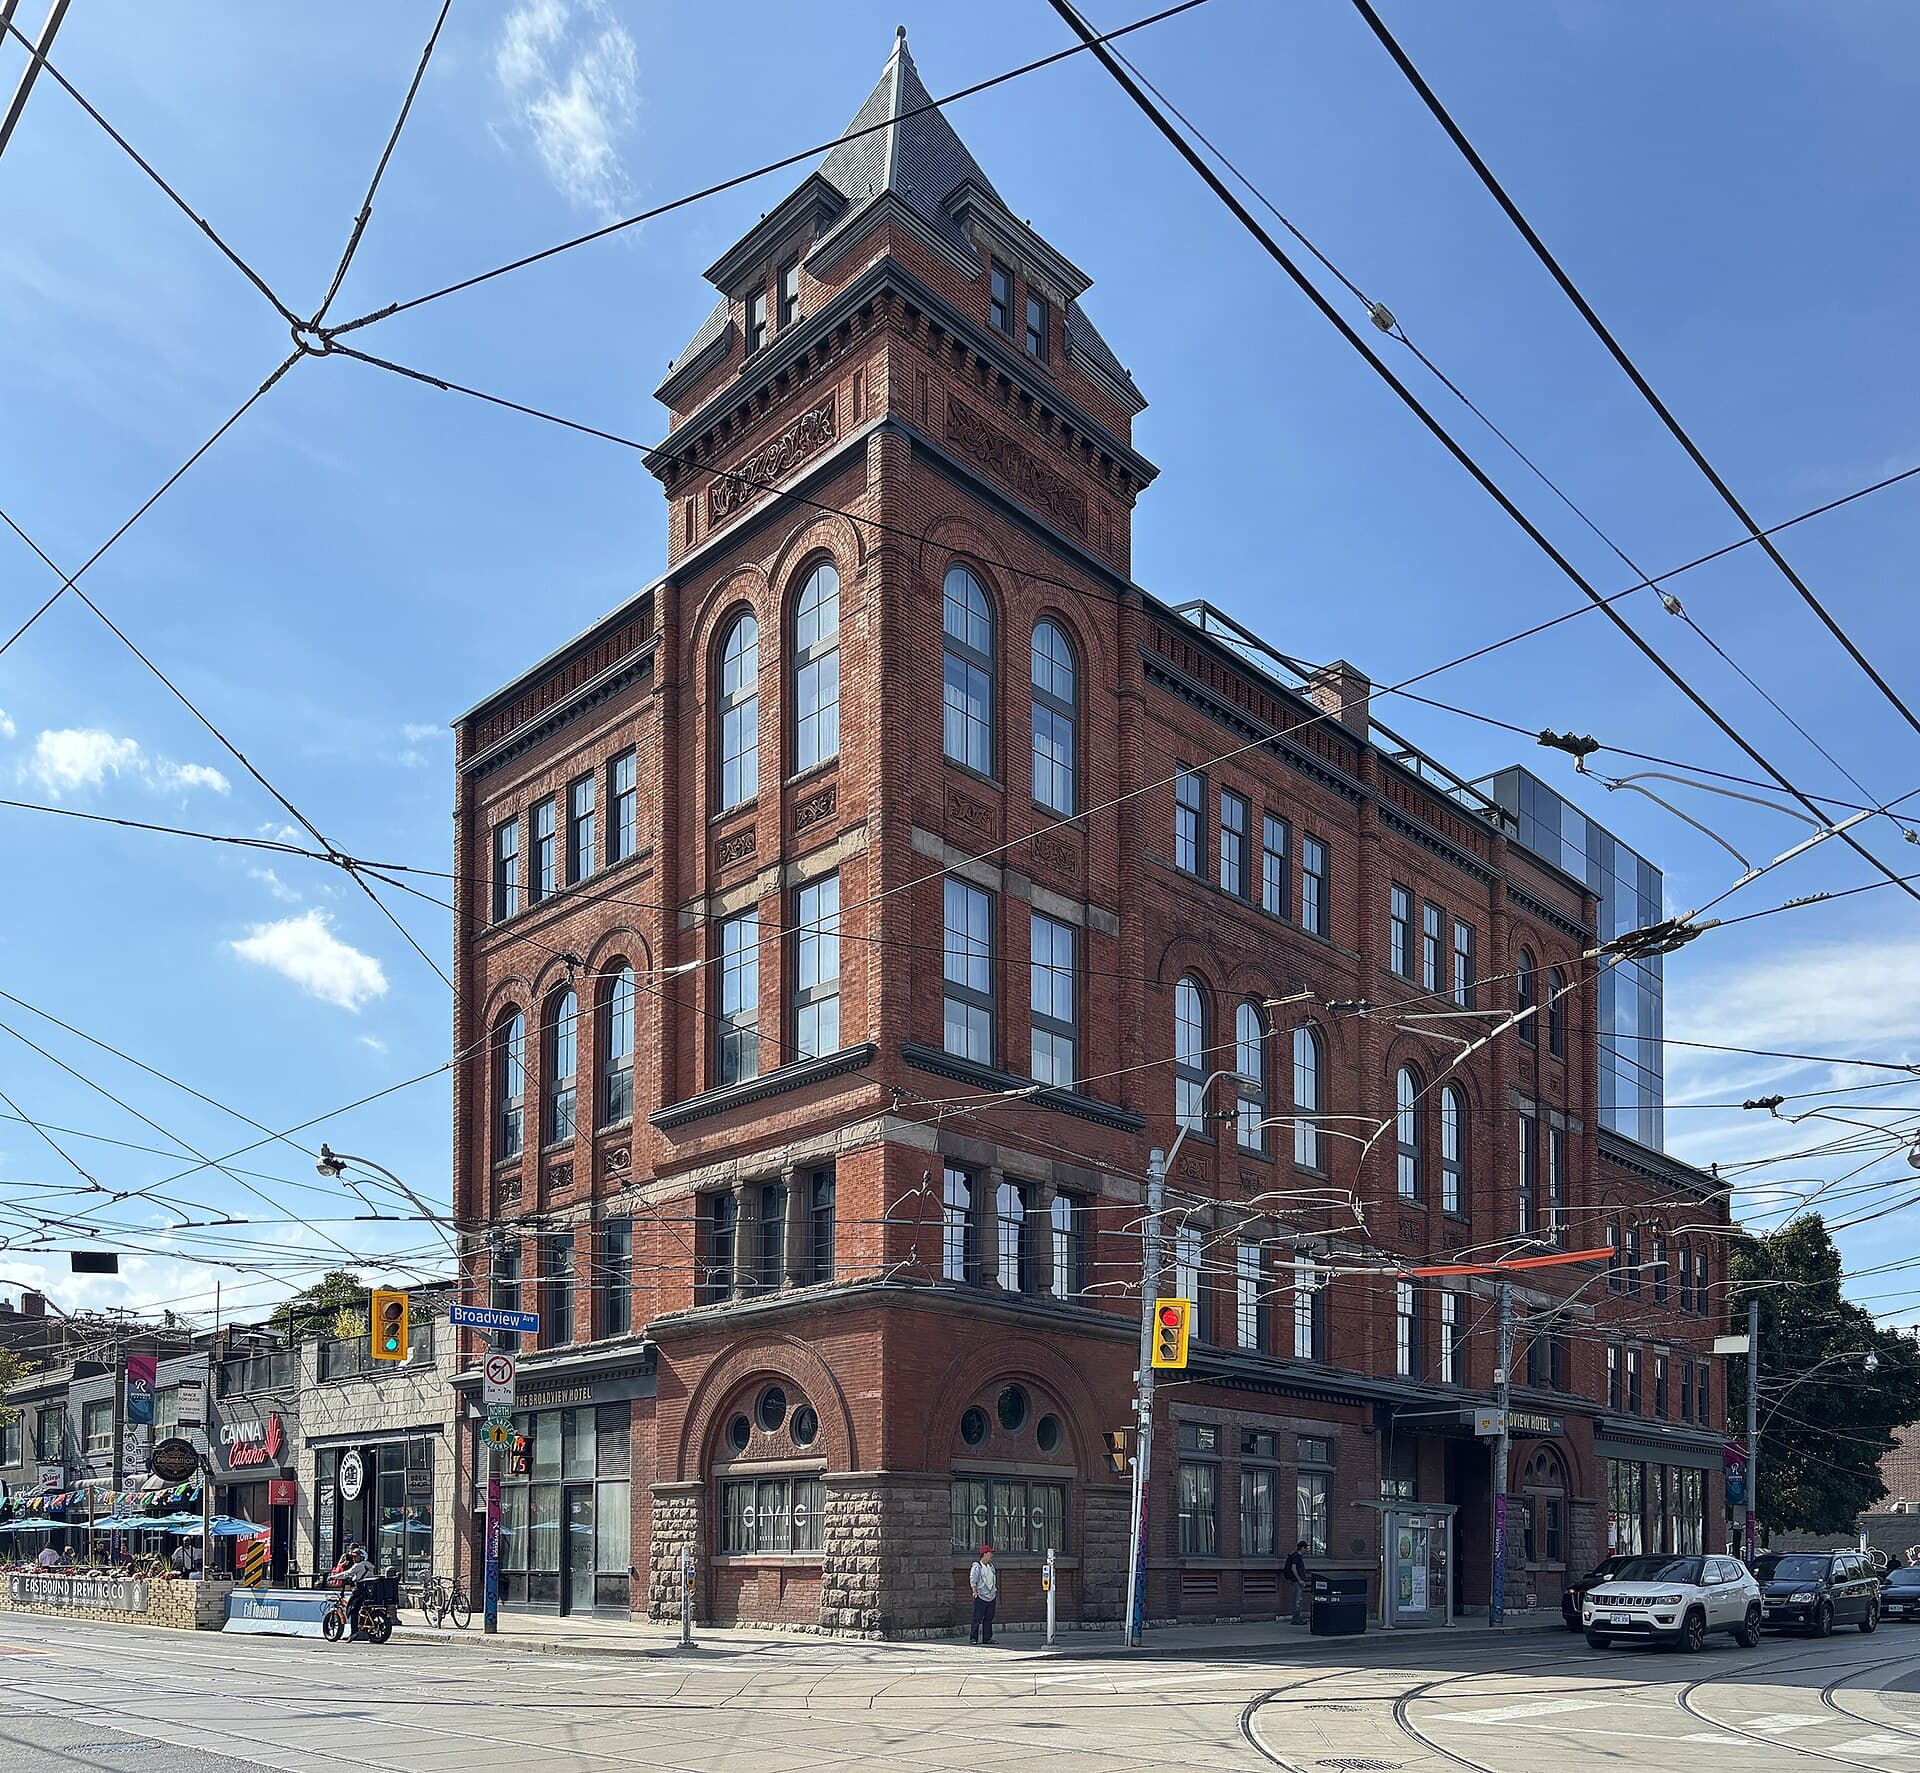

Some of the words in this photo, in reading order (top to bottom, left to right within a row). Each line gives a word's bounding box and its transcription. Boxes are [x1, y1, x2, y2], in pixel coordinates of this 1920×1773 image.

[454, 1307, 521, 1327] Broadview
[522, 1314, 535, 1323] Ave
[516, 1395, 528, 1408] THE
[528, 1389, 569, 1406] BROADVIEW
[569, 1386, 592, 1401] HOTEL
[489, 1406, 510, 1417] NORTH
[220, 1421, 264, 1445] CANNA
[1531, 1415, 1551, 1432] HOTEL
[228, 1441, 268, 1468] Cabana
[743, 1503, 807, 1528] CIVIC
[973, 1504, 1044, 1529] CIVIC
[25, 1579, 70, 1596] EASTBOUND
[72, 1582, 109, 1599] BREWING
[111, 1583, 124, 1599] CO
[252, 1602, 280, 1619] TORONTO
